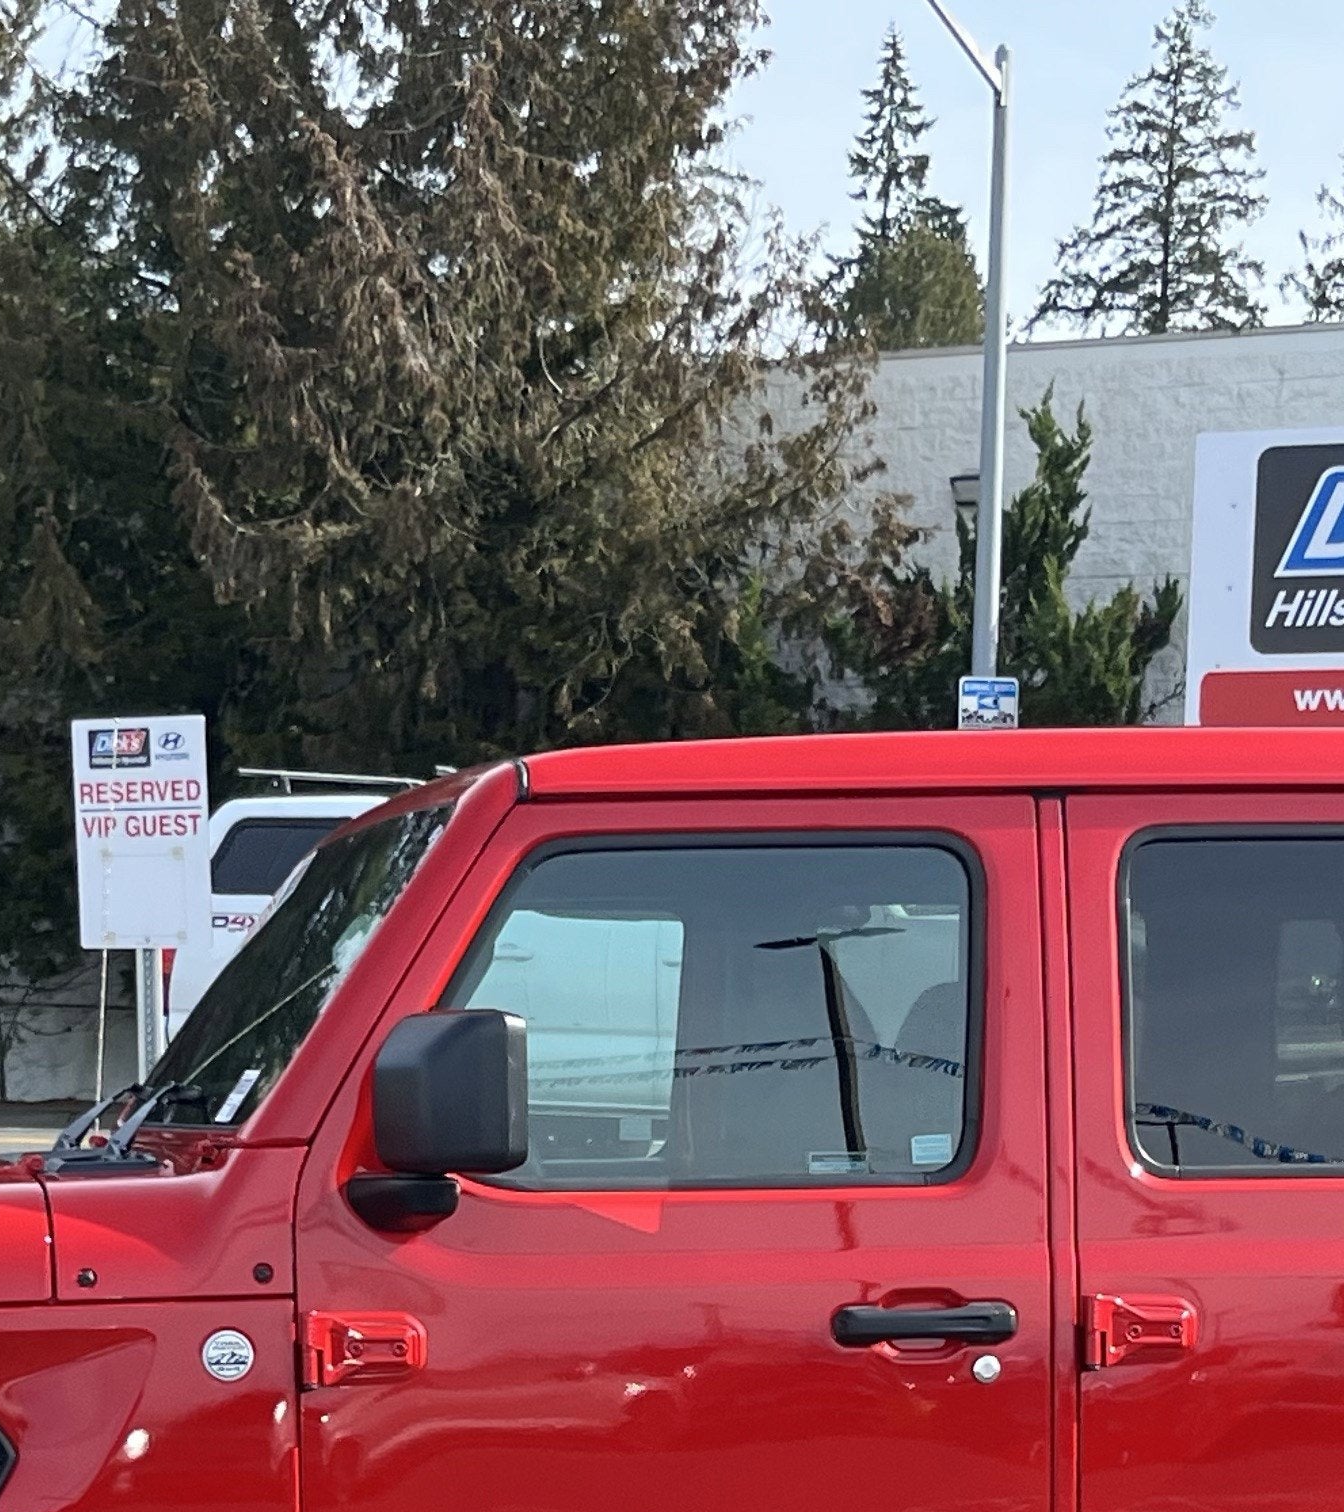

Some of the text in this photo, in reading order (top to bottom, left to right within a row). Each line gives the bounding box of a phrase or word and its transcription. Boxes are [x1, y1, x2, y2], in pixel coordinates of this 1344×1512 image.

[78, 779, 202, 804] RESERVED
[81, 814, 202, 838] VIP GUEST
